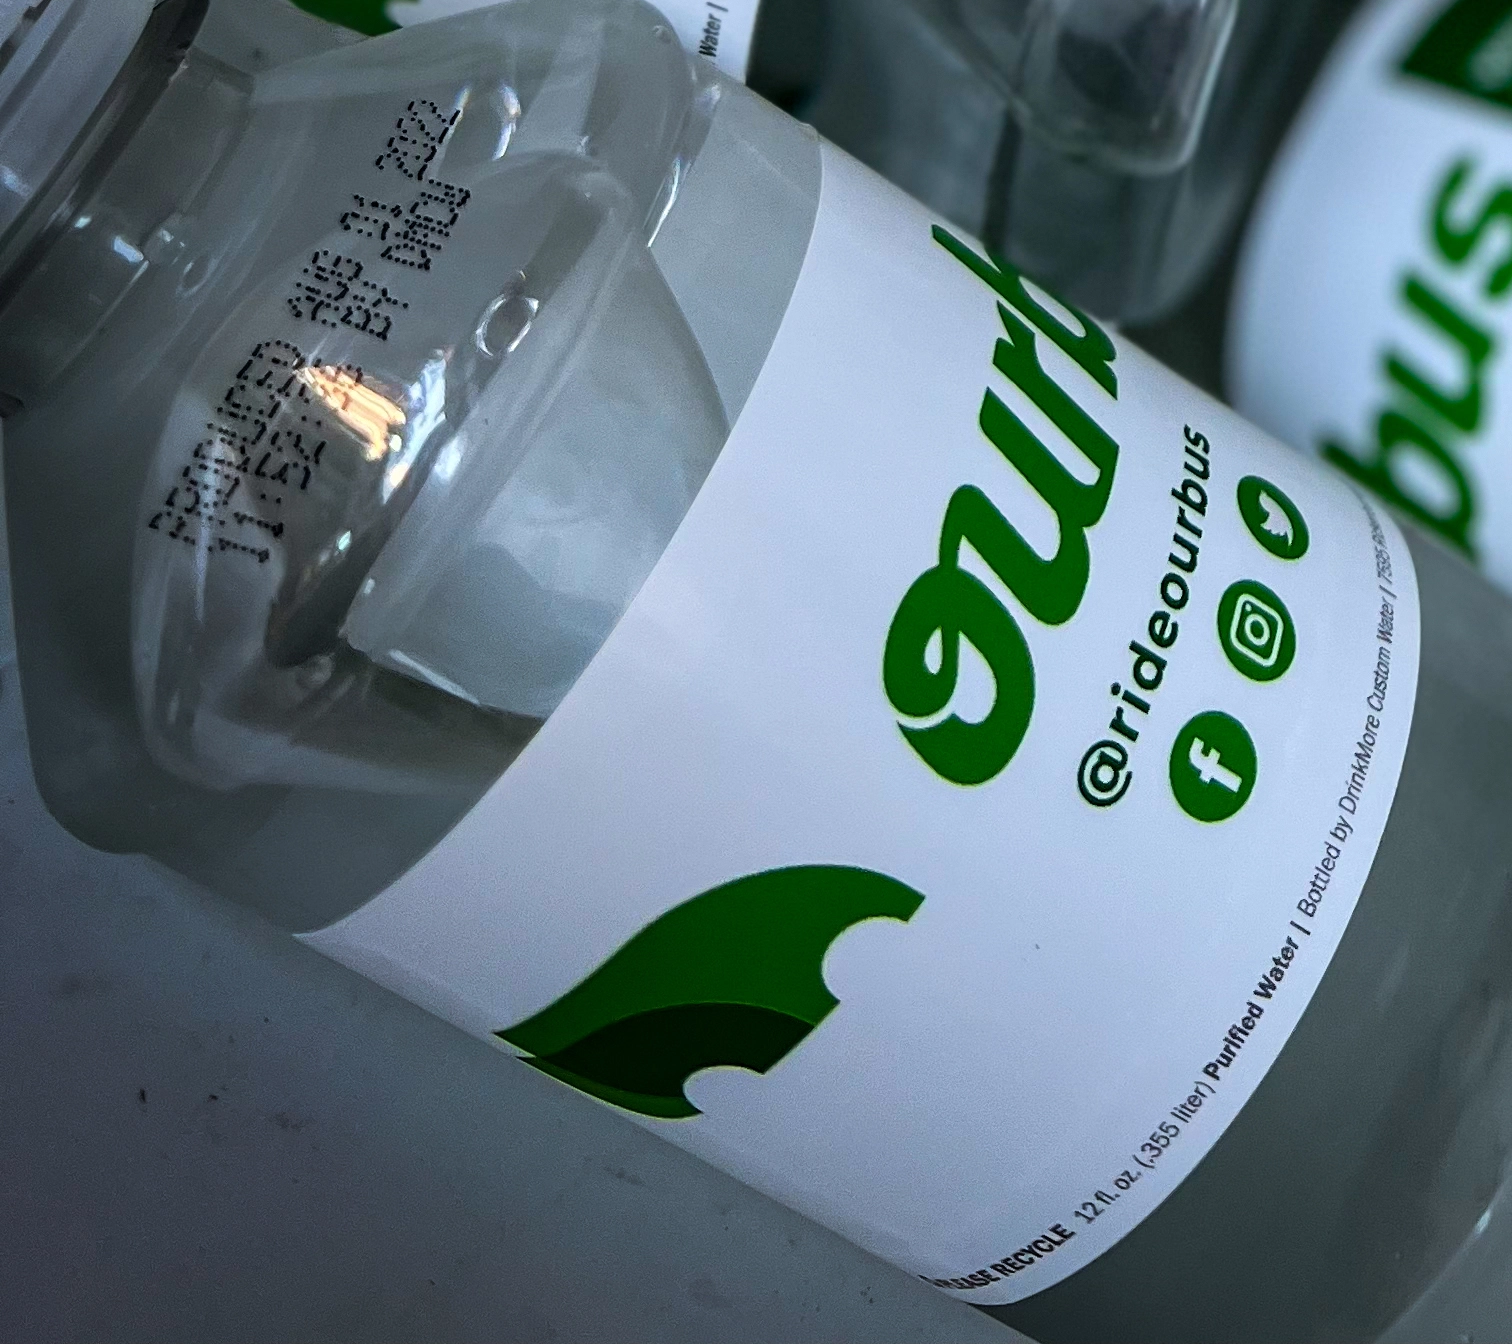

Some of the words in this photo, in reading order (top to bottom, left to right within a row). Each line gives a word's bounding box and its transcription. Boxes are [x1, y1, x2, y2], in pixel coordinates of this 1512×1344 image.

[699, 13, 721, 57] Water
[341, 281, 409, 340] BY
[381, 179, 471, 270] DMCW
[149, 339, 305, 546] PRODUCED
[288, 250, 364, 328] AUG
[340, 193, 403, 239] 01
[375, 99, 462, 180] 2022
[1077, 424, 1212, 807] @rideourbus
[1376, 596, 1395, 644] Water
[1367, 645, 1391, 712] Custom
[1338, 714, 1380, 814] DrinkMore
[1330, 815, 1354, 843] by
[1297, 842, 1341, 917] Bottled
[1254, 936, 1299, 999] Water
[1202, 1001, 1264, 1080] Purified
[1170, 1080, 1216, 1123] liter)
[1133, 1121, 1180, 1169] (.355
[1095, 1190, 1120, 1205] fl.
[1114, 1170, 1141, 1191] oz.
[1075, 1201, 1105, 1224] 12
[996, 1223, 1077, 1277] RECYCLE
